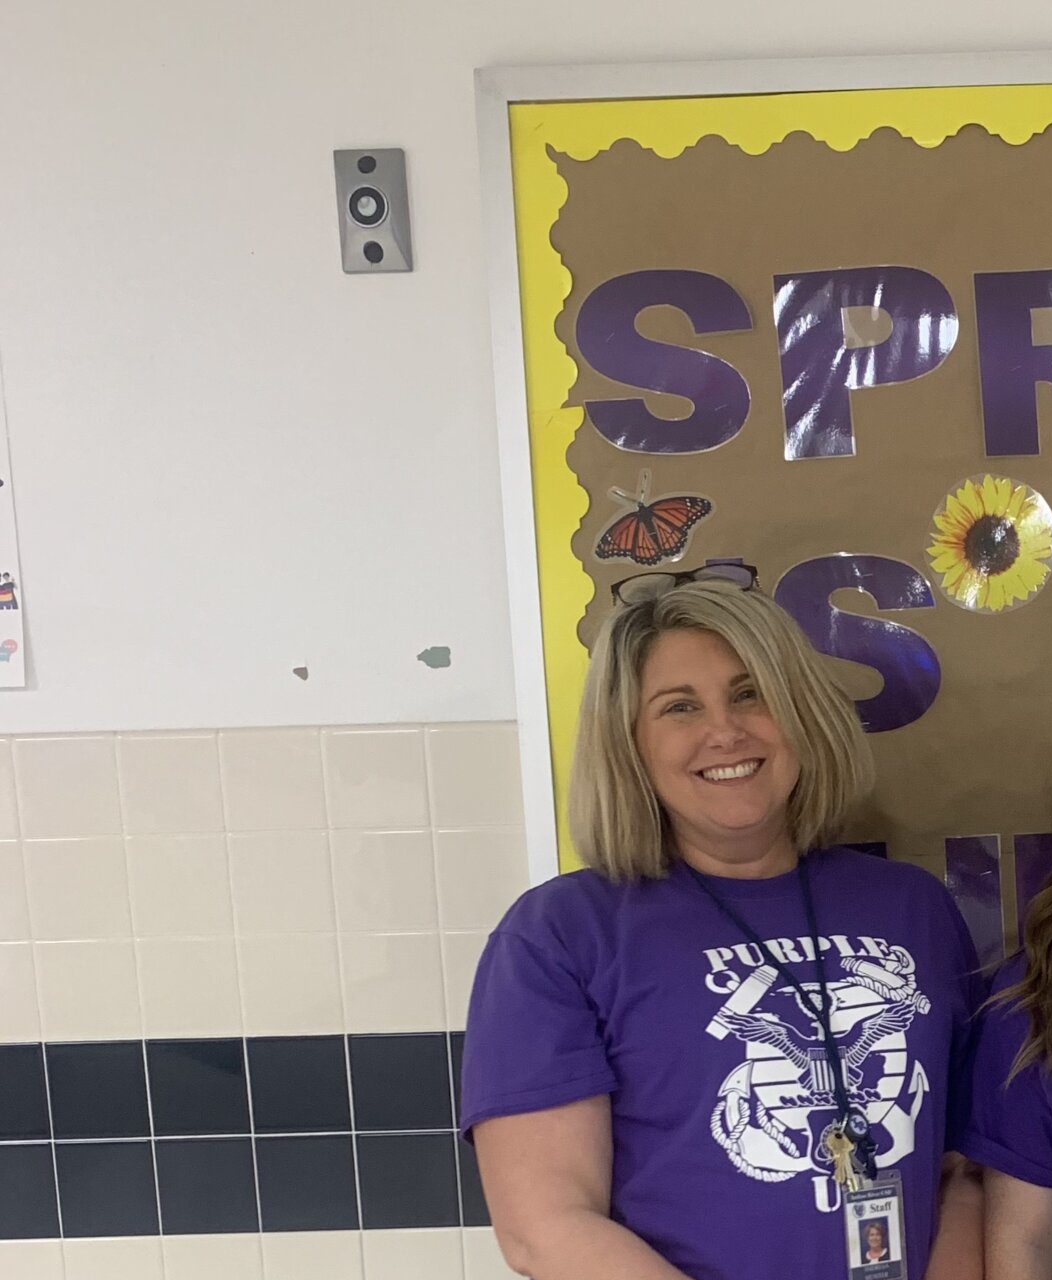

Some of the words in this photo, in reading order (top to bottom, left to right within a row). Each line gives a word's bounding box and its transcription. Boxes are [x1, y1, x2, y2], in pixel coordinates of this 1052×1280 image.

[703, 935, 889, 973] PURPLE
[812, 1176, 841, 1212] U
[870, 1201, 892, 1214] Staff
